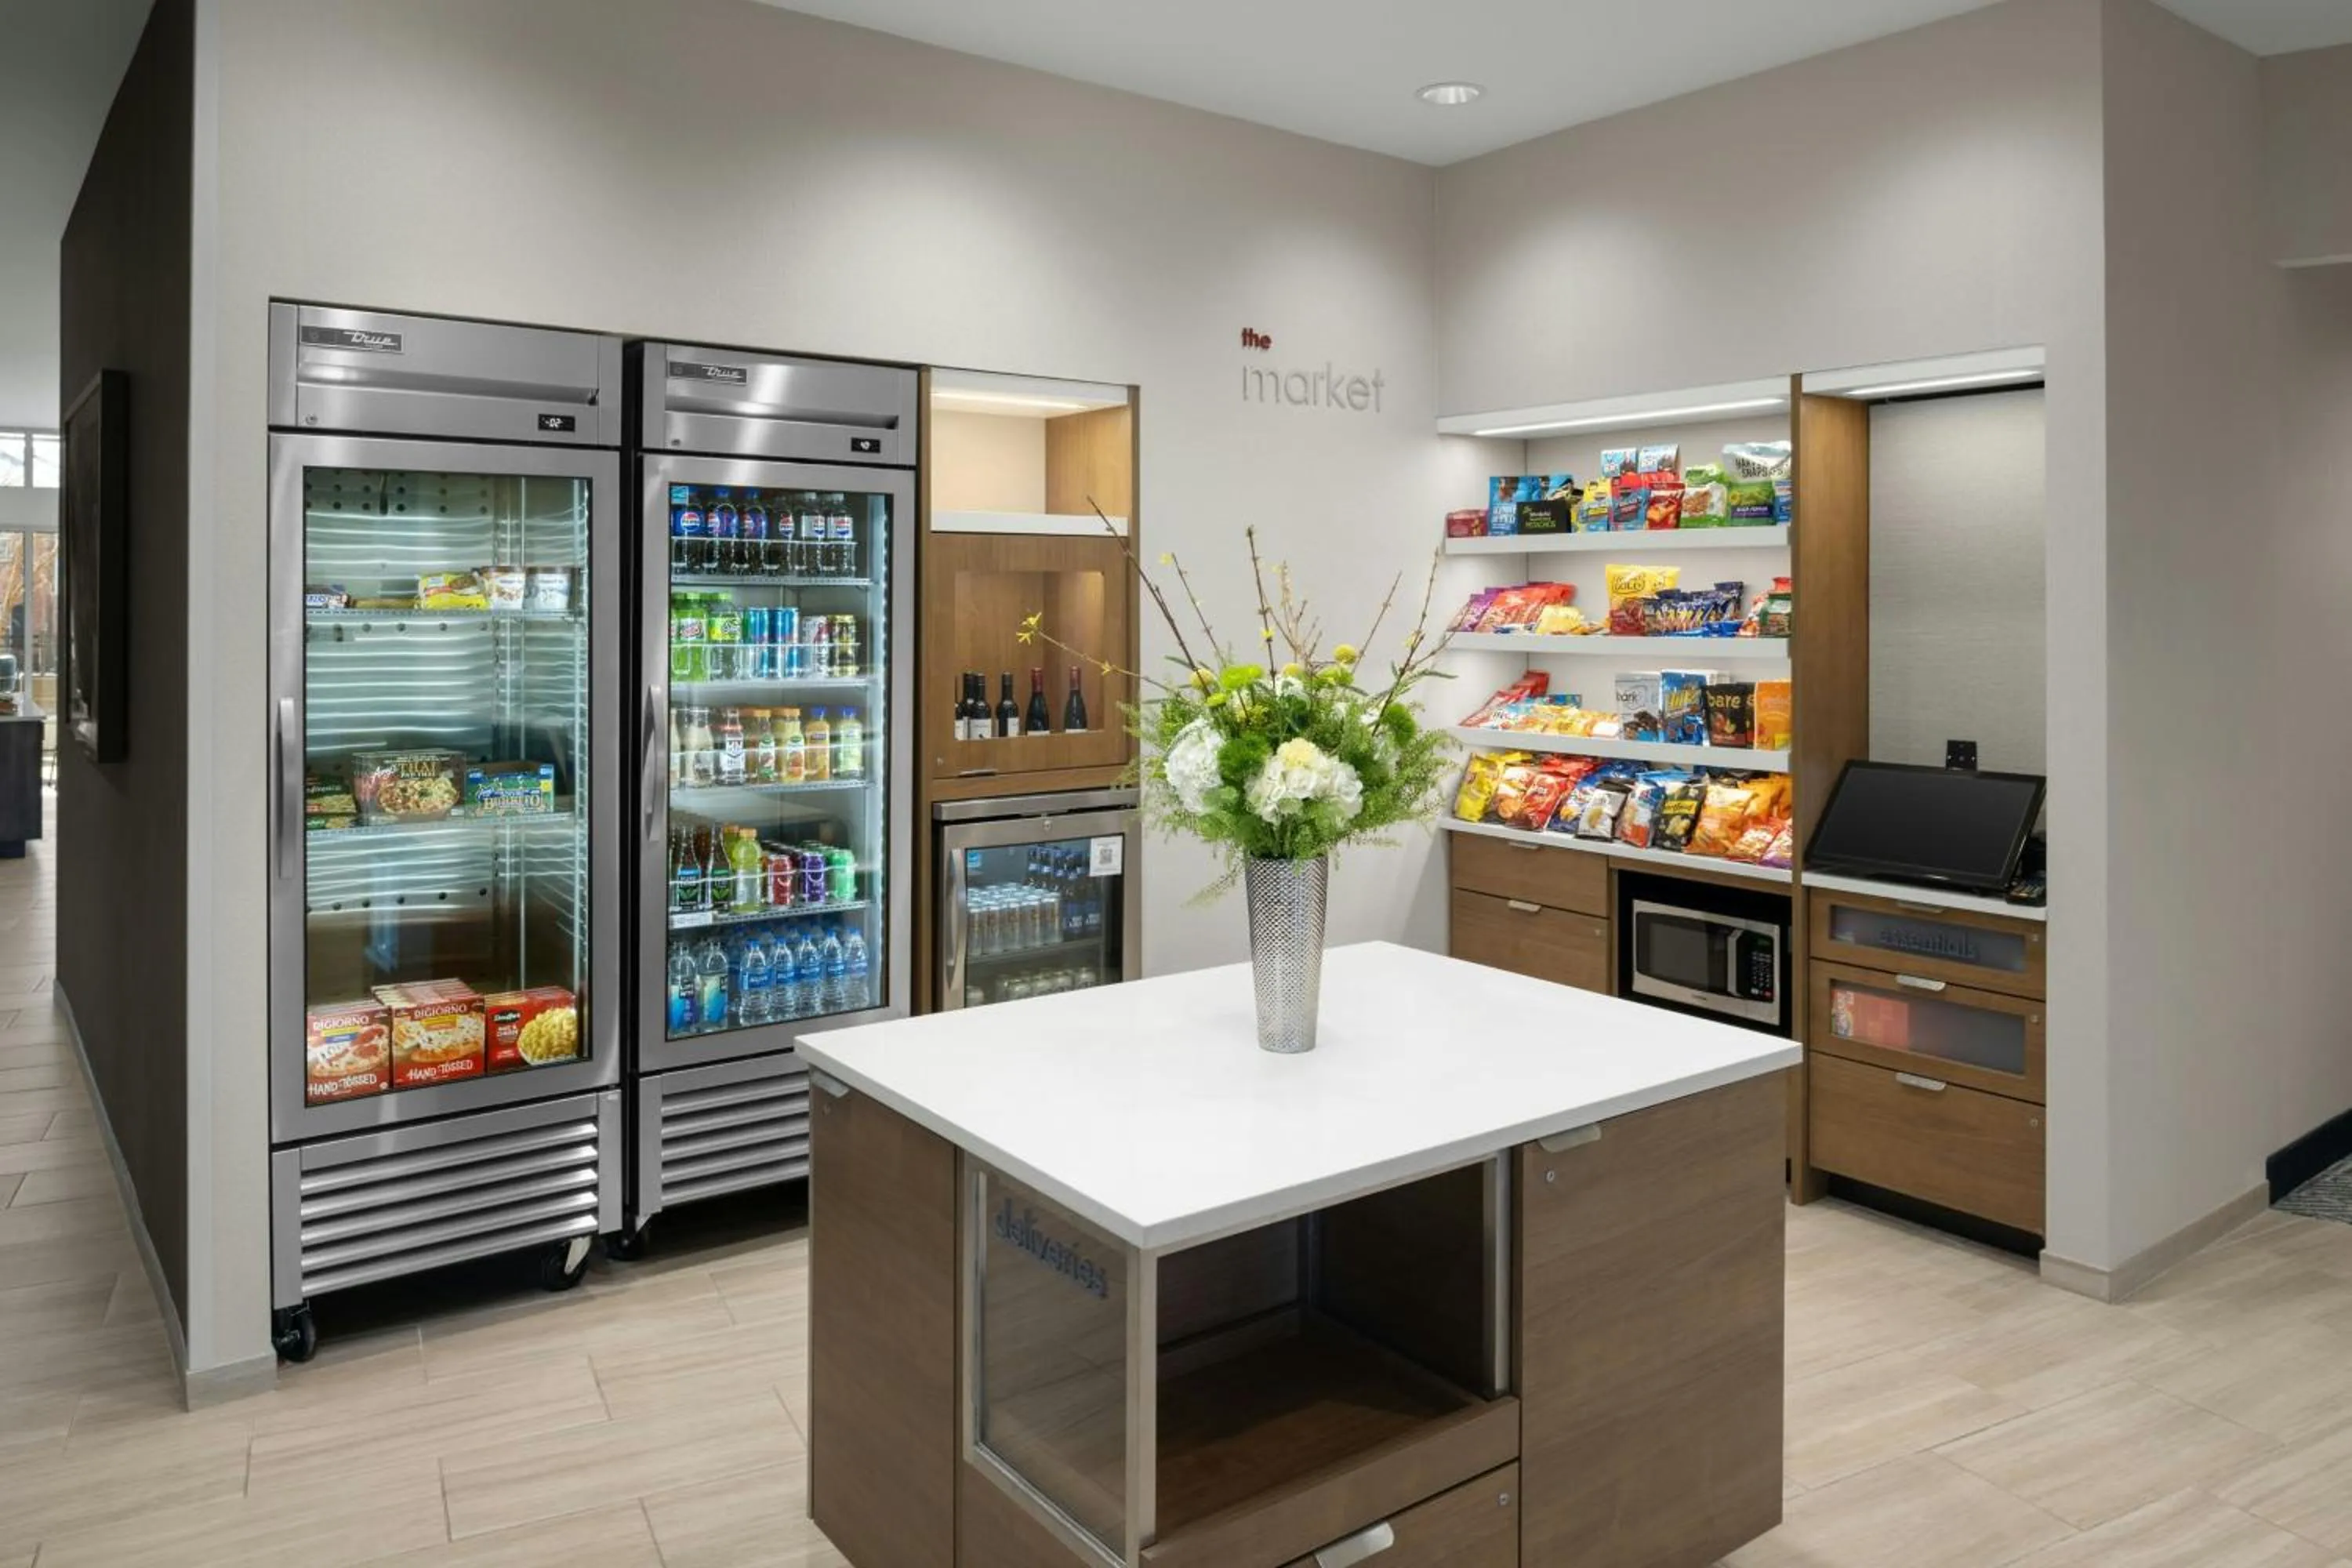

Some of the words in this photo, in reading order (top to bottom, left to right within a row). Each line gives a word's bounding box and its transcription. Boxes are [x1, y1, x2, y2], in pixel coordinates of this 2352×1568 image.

[1242, 328, 1272, 350] the
[1243, 361, 1385, 413] market
[1706, 690, 1741, 709] bare
[1882, 927, 1976, 959] essentials
[995, 1197, 1110, 1299] deliveries
